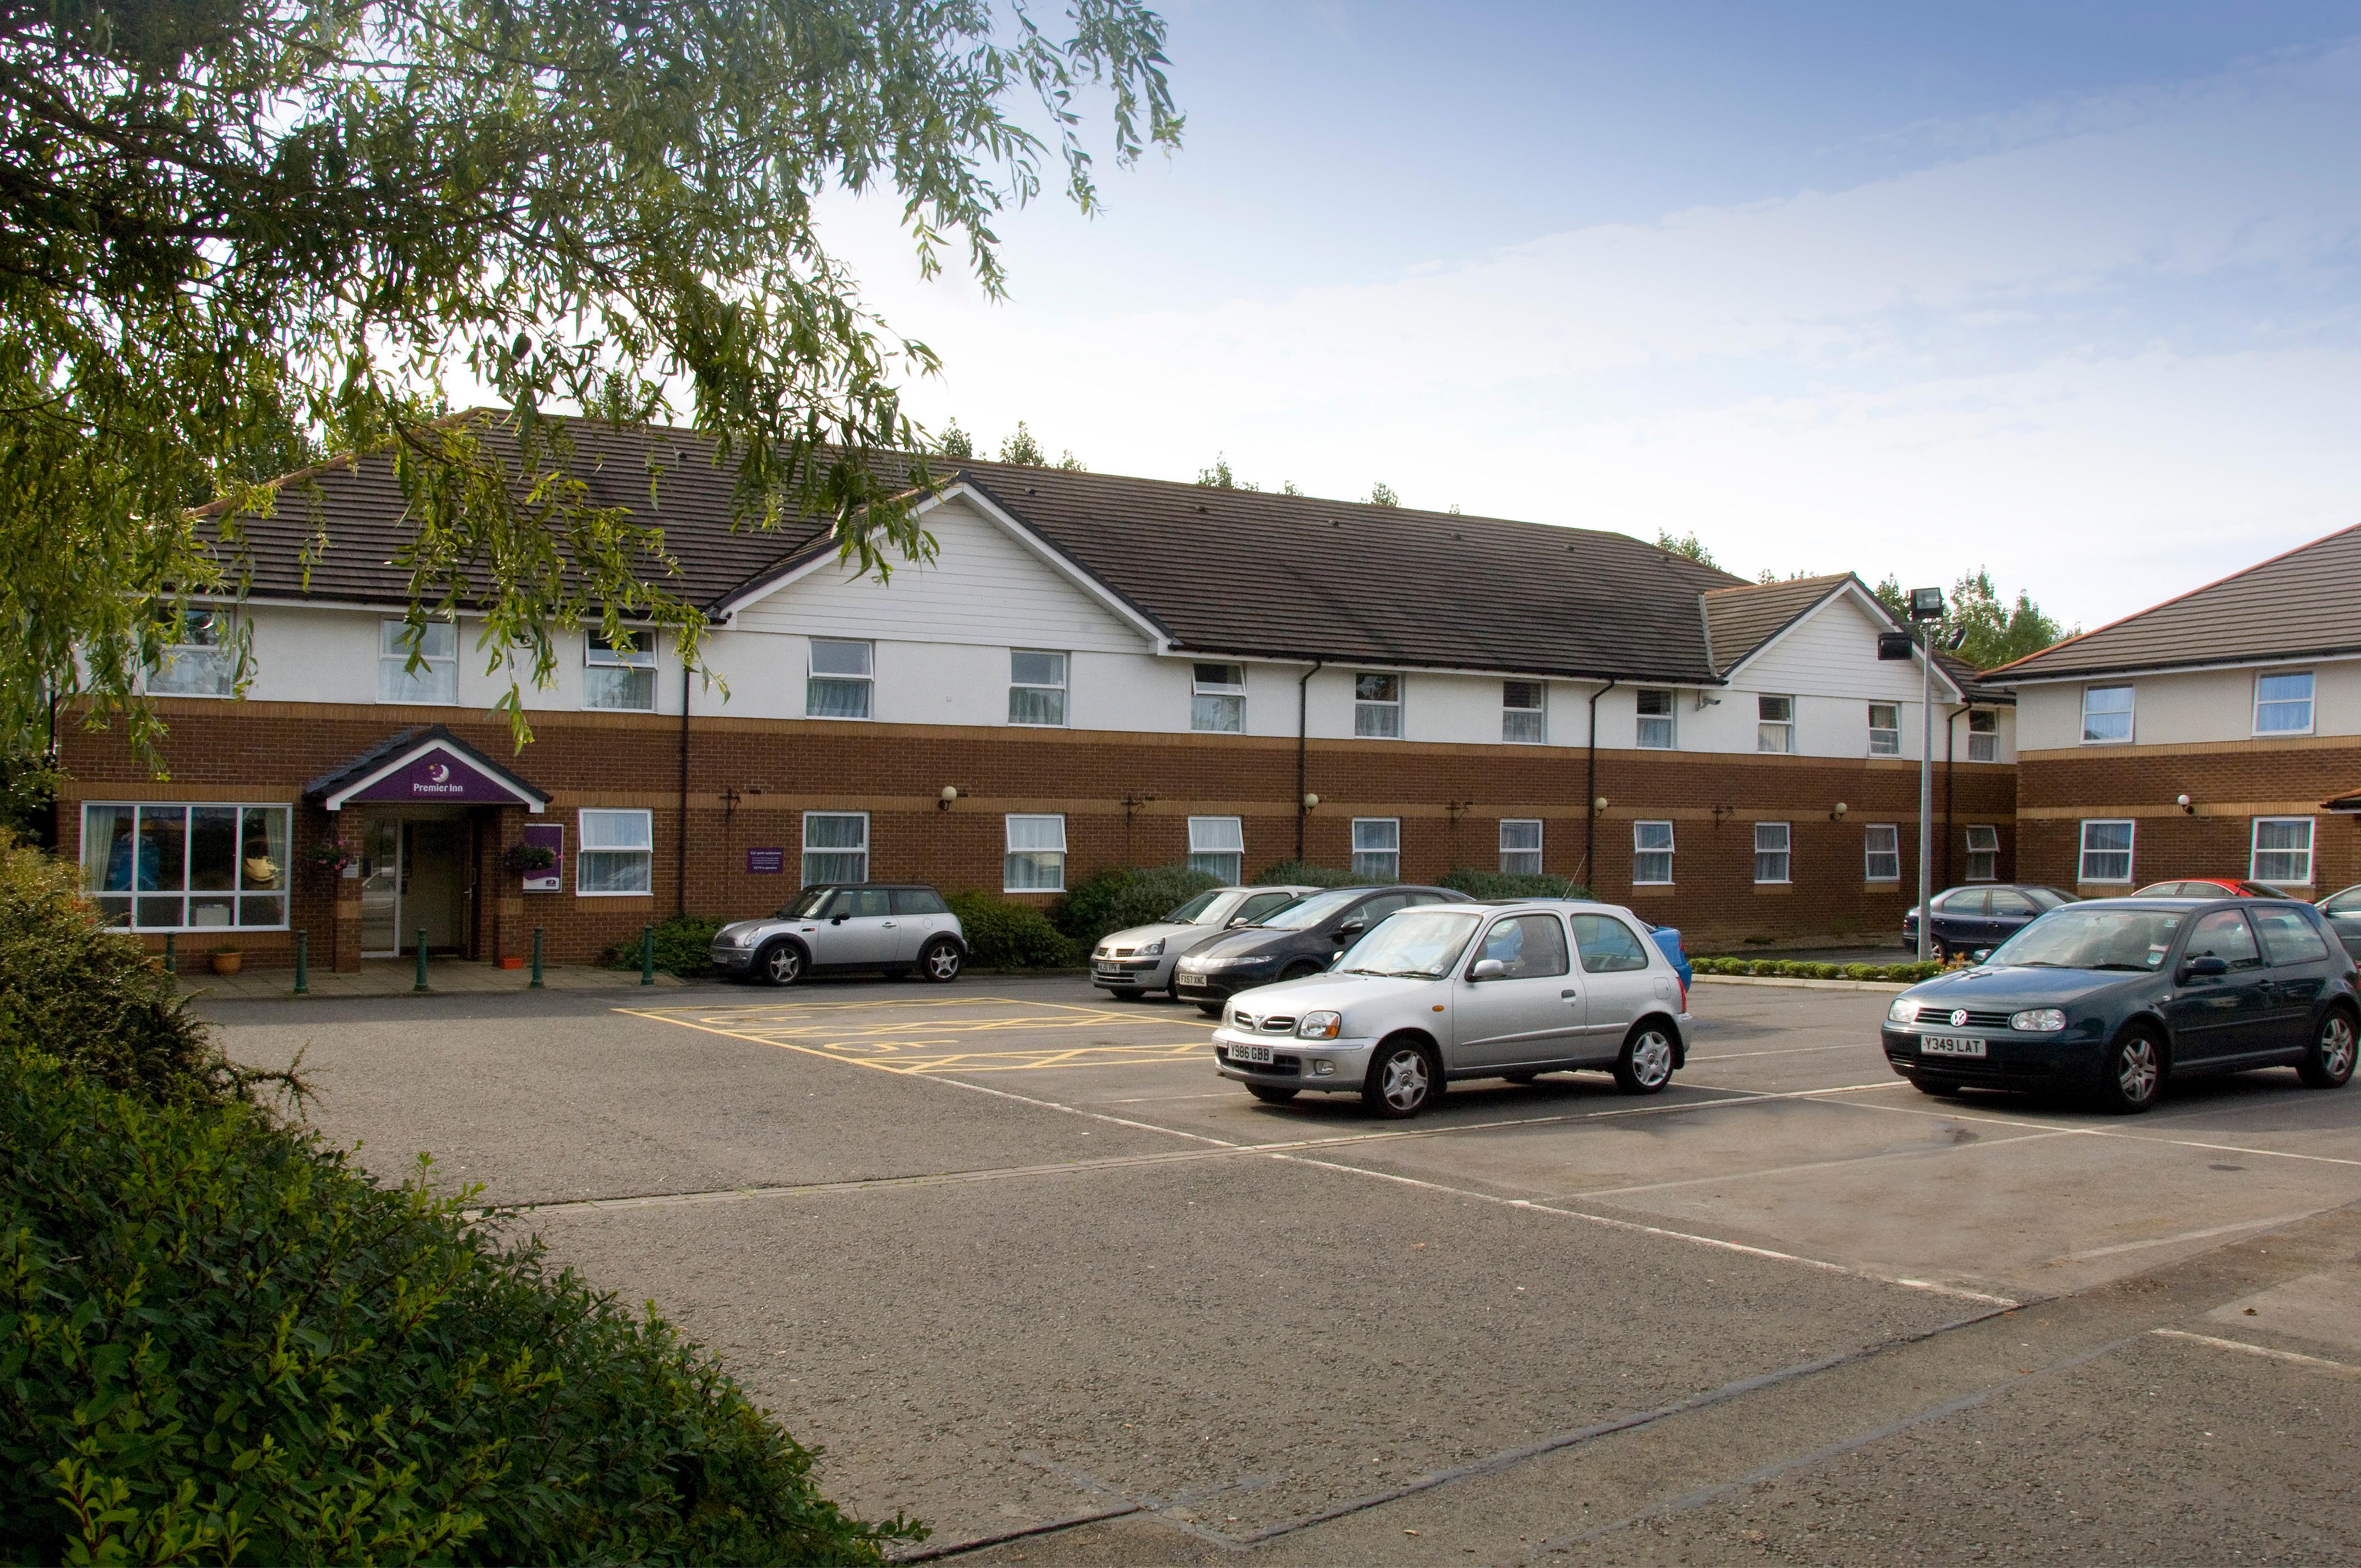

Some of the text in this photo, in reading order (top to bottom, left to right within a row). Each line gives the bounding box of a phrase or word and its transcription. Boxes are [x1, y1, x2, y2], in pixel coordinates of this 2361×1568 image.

[414, 783, 463, 792] Premier Inn
[1194, 976, 1204, 984] XNC
[1925, 1037, 1980, 1053] Y349 LAT
[1231, 1043, 1269, 1061] Y986 GBB
